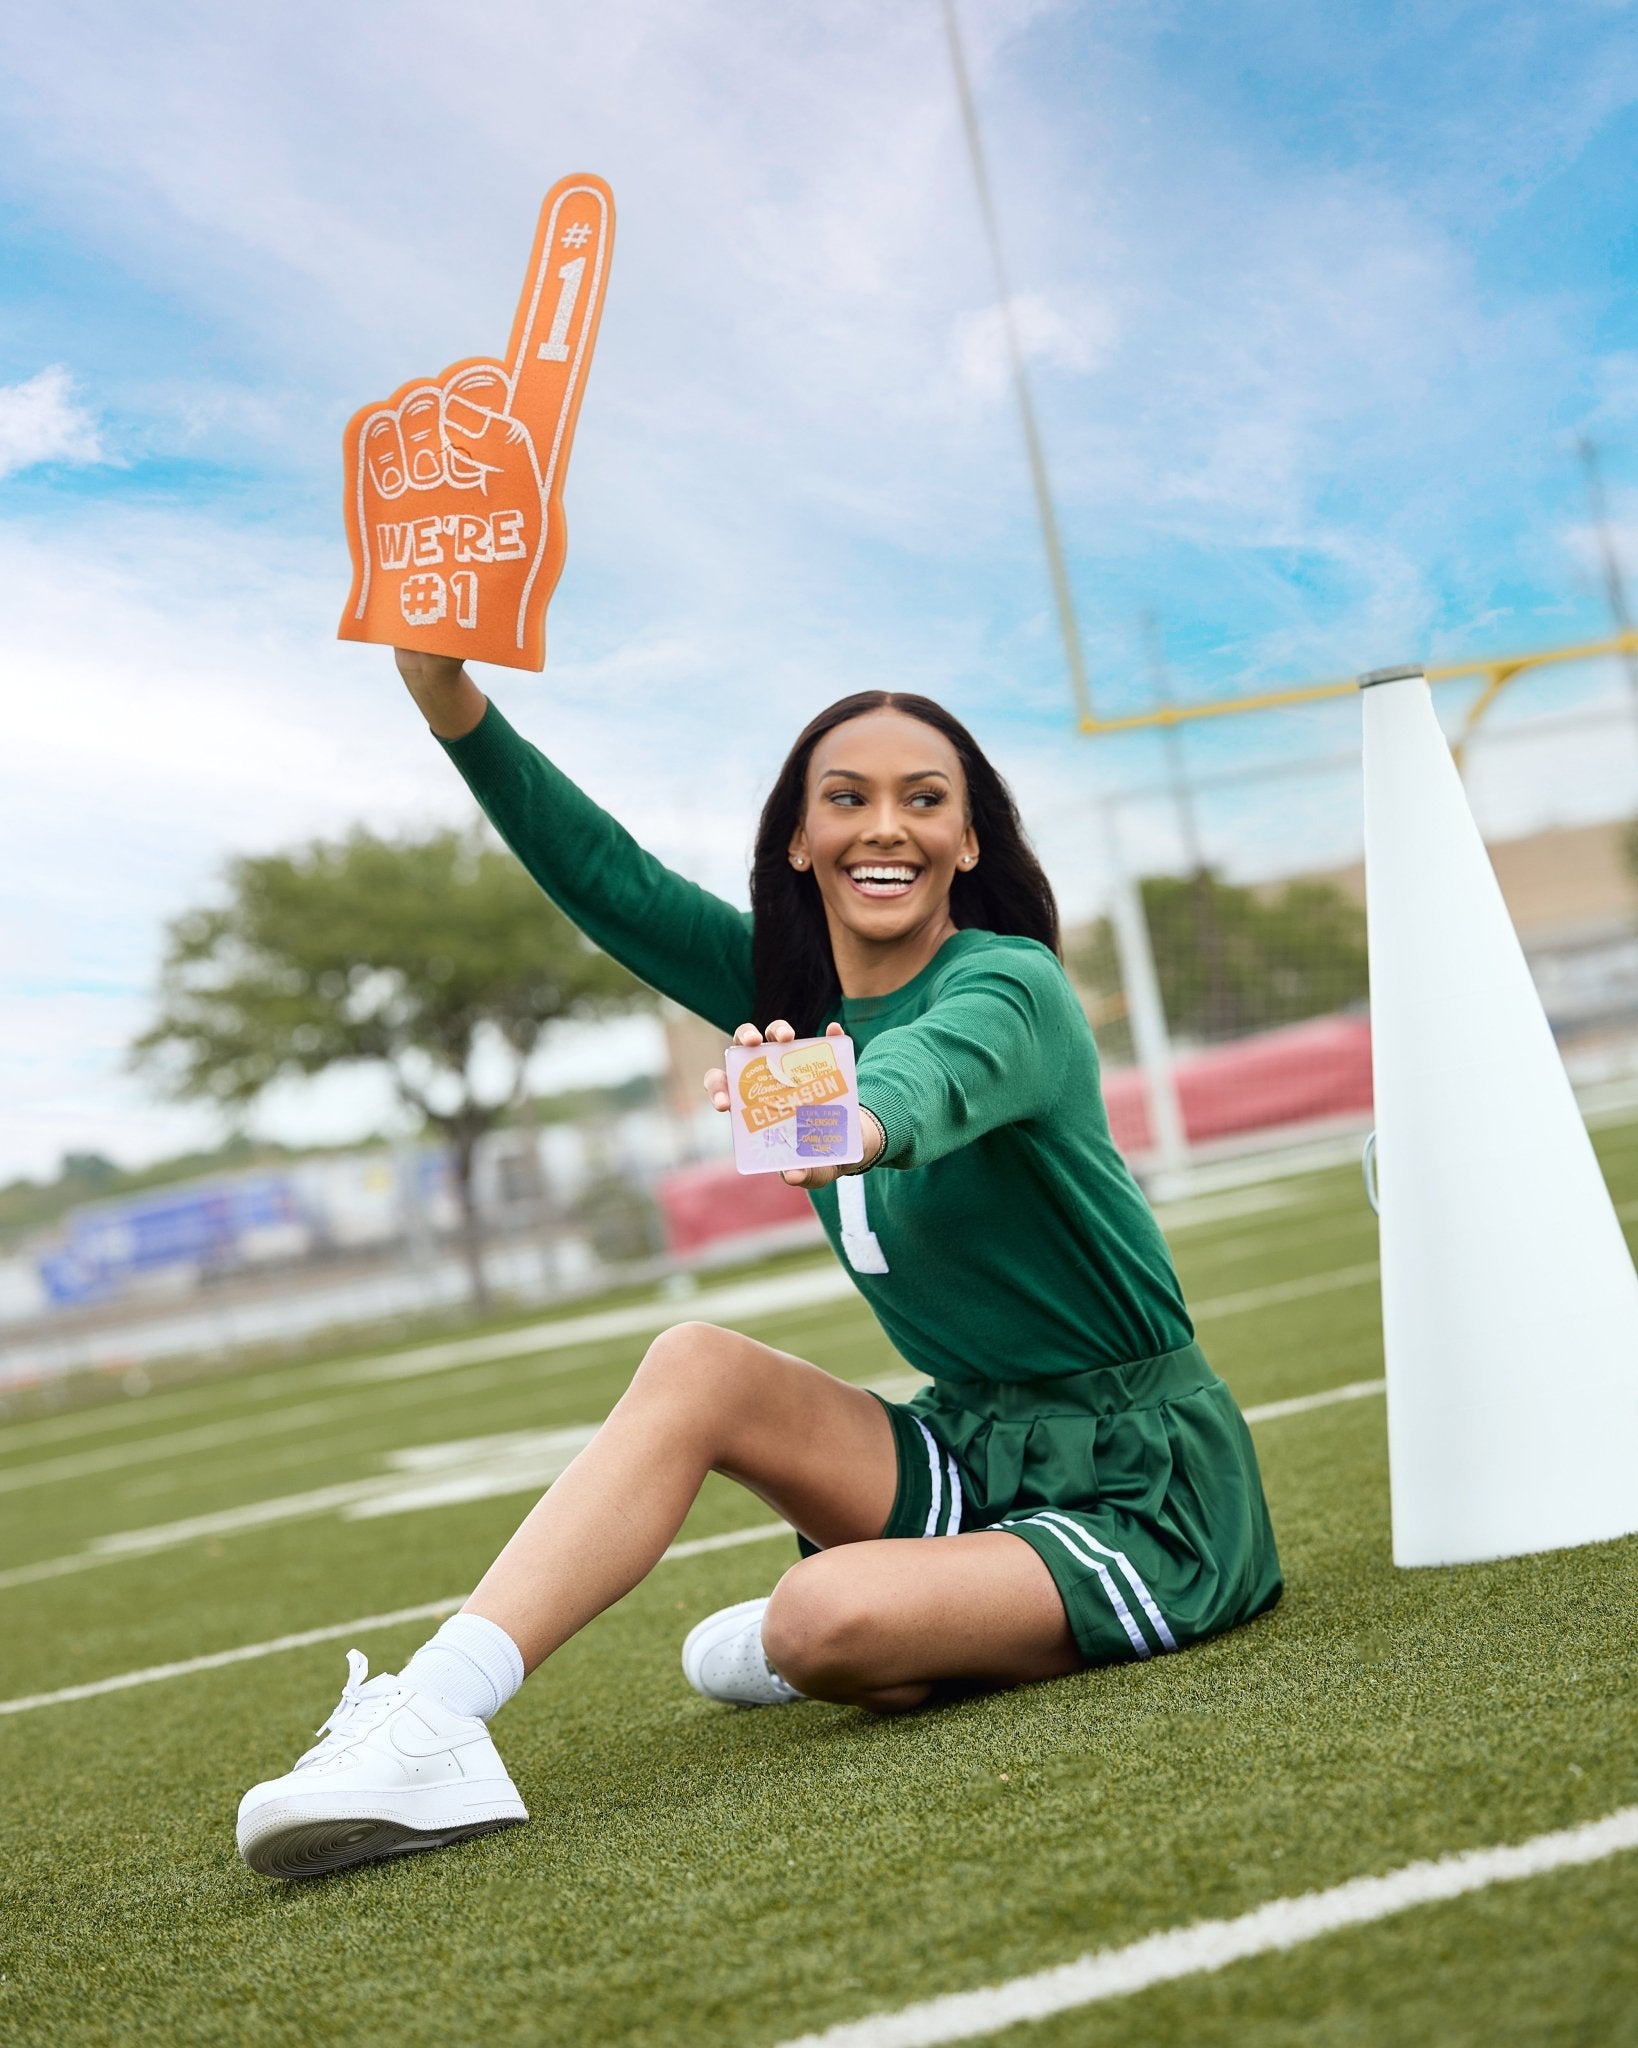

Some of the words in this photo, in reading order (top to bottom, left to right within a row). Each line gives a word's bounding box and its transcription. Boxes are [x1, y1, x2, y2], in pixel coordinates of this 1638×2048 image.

[560, 222, 592, 248] #
[537, 256, 587, 362] 1
[375, 509, 527, 570] WE'RE
[400, 571, 478, 629] #1
[746, 1065, 764, 1078] GOOD
[813, 1061, 828, 1070] You
[751, 1076, 840, 1126] CLEMSON
